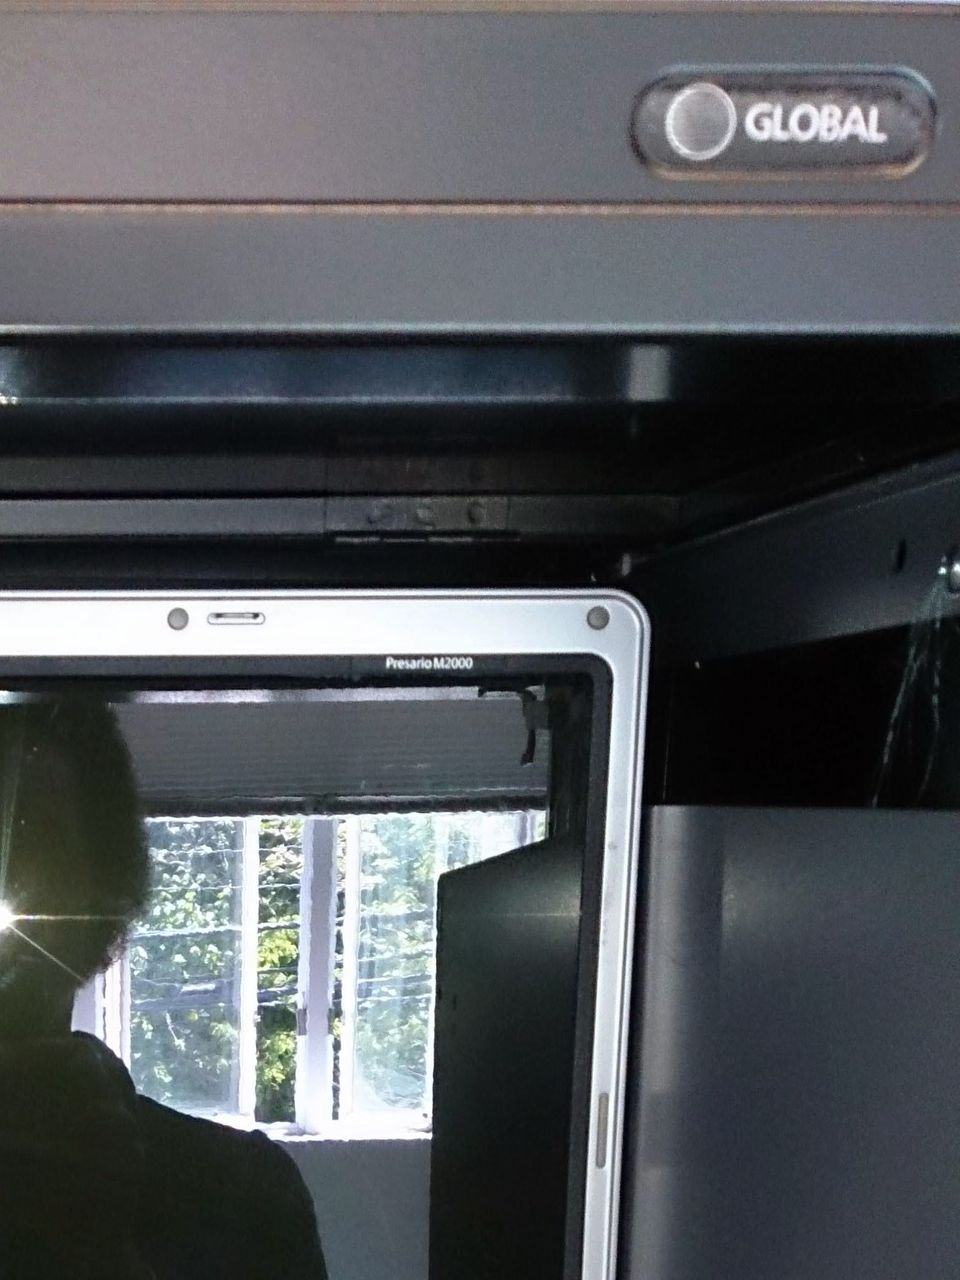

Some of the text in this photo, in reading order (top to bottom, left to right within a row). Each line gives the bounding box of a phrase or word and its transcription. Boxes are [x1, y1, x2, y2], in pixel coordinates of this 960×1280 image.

[744, 102, 887, 144] GLOBAL
[386, 657, 474, 670] Presario M2000
